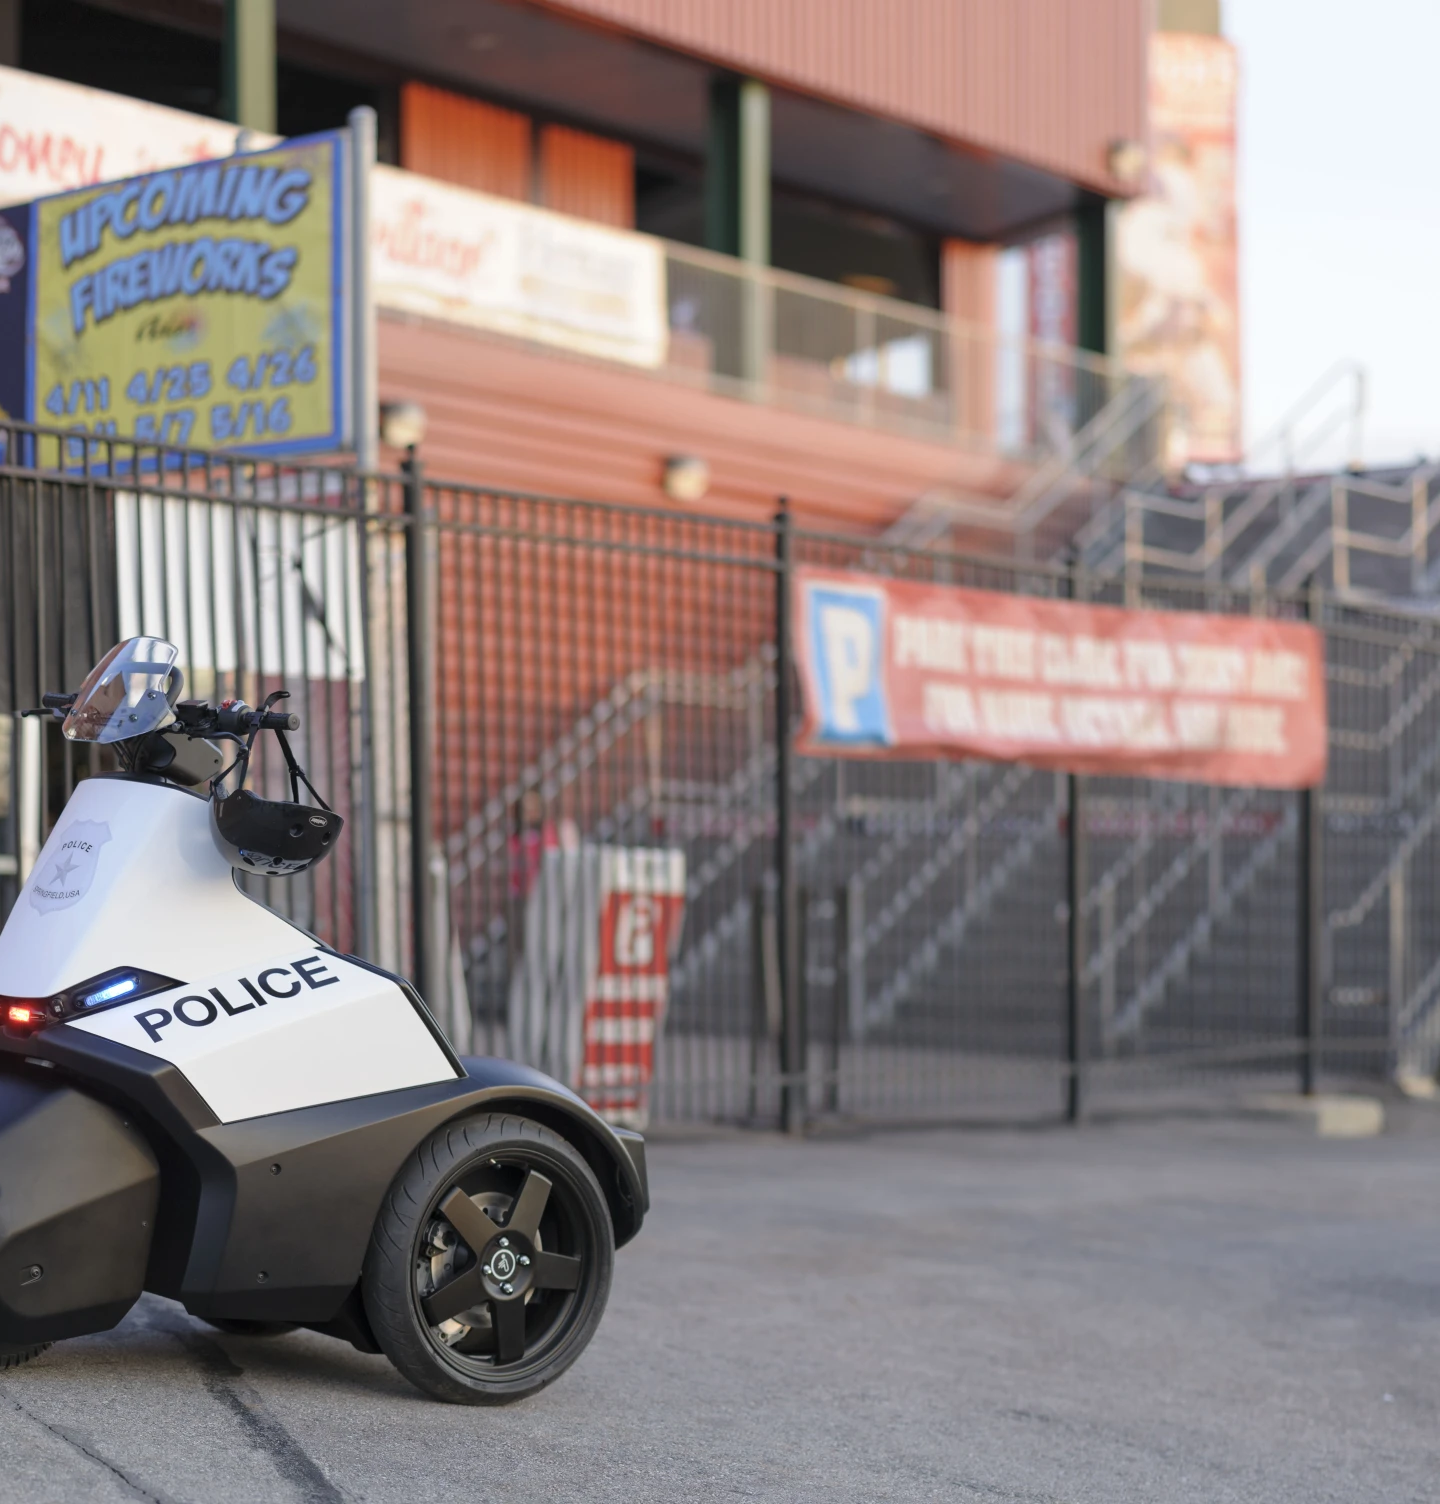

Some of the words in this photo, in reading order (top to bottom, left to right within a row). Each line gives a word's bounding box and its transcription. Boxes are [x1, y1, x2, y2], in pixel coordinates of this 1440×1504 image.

[59, 165, 311, 271] UPCOMING
[70, 236, 298, 337] FIREWORKS
[44, 375, 110, 417] 4/11
[125, 360, 212, 405] 4/25
[226, 345, 318, 391] 4/26
[211, 396, 293, 440] 5/16
[819, 604, 875, 733] P
[62, 840, 93, 853] POLICE
[134, 955, 341, 1044] POLICE
